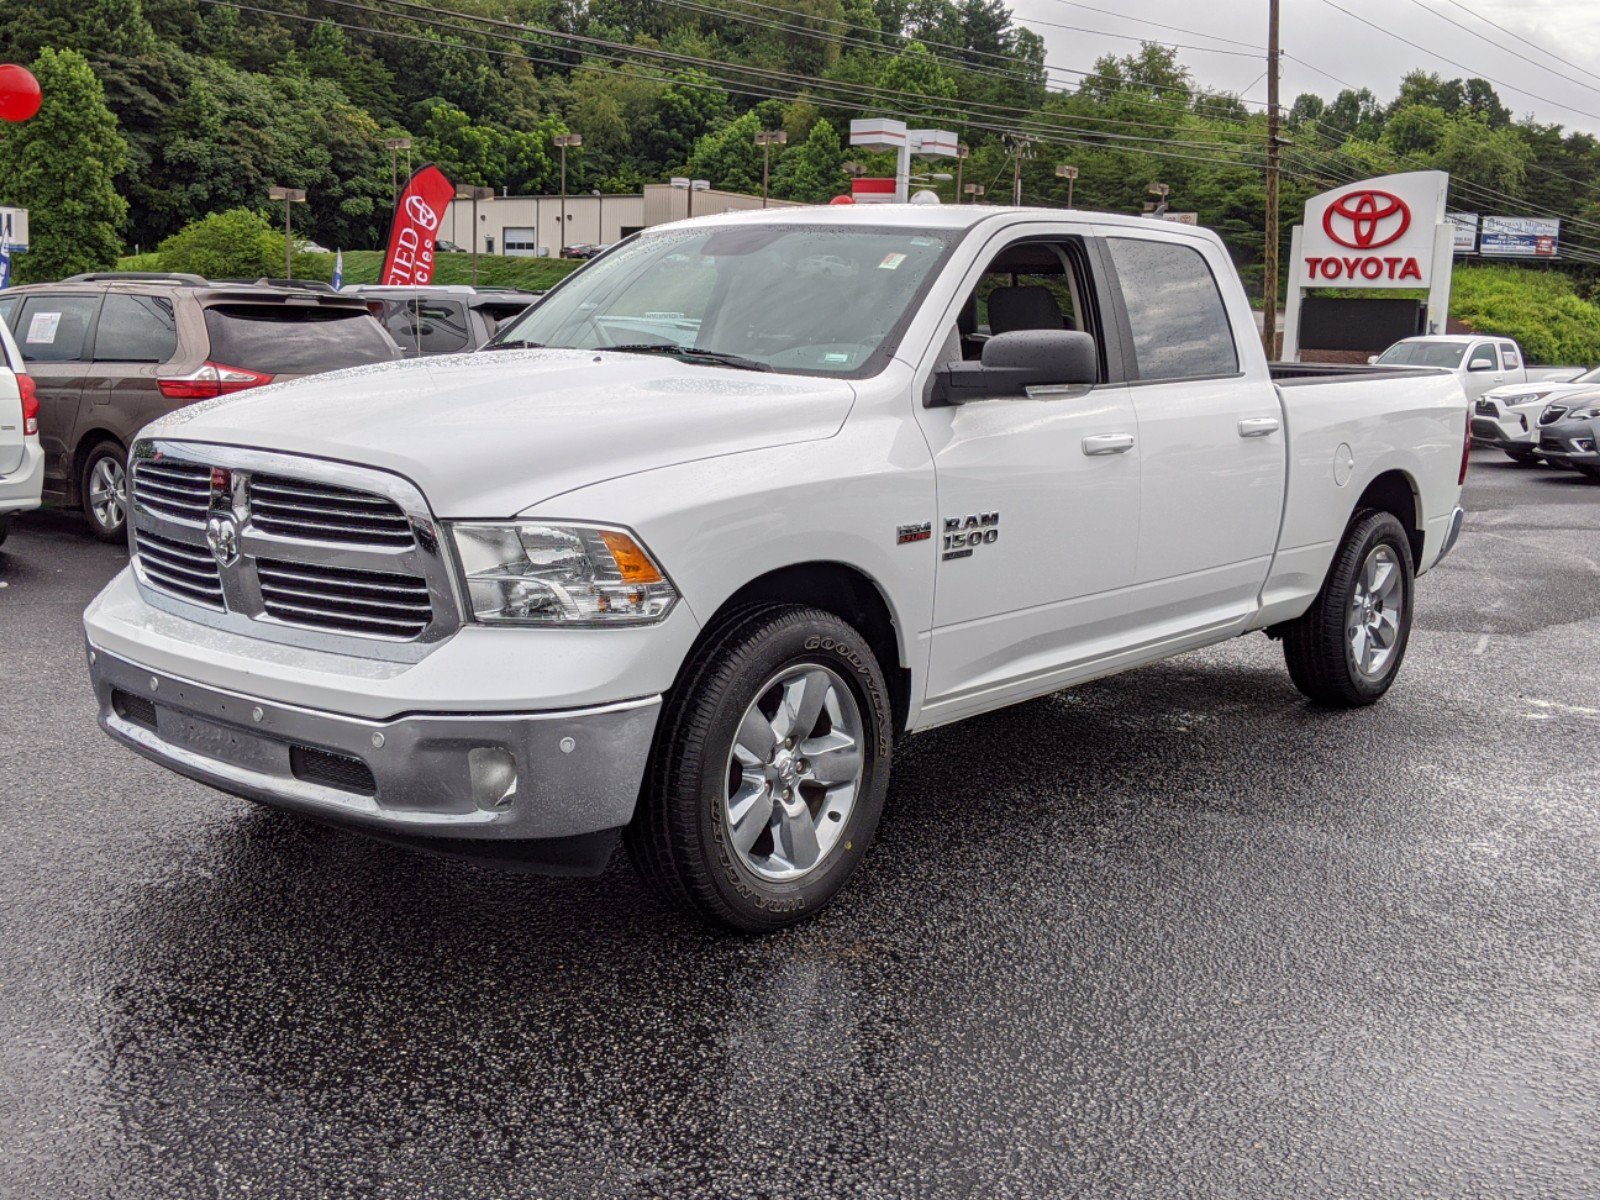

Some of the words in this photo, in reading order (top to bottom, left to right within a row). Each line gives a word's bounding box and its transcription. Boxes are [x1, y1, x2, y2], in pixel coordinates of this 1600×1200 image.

[413, 240, 433, 285] cles
[1304, 256, 1422, 280] TOYOTA
[943, 511, 999, 533] RAM
[943, 529, 999, 550] 1500
[804, 634, 889, 759] GOODYEAR
